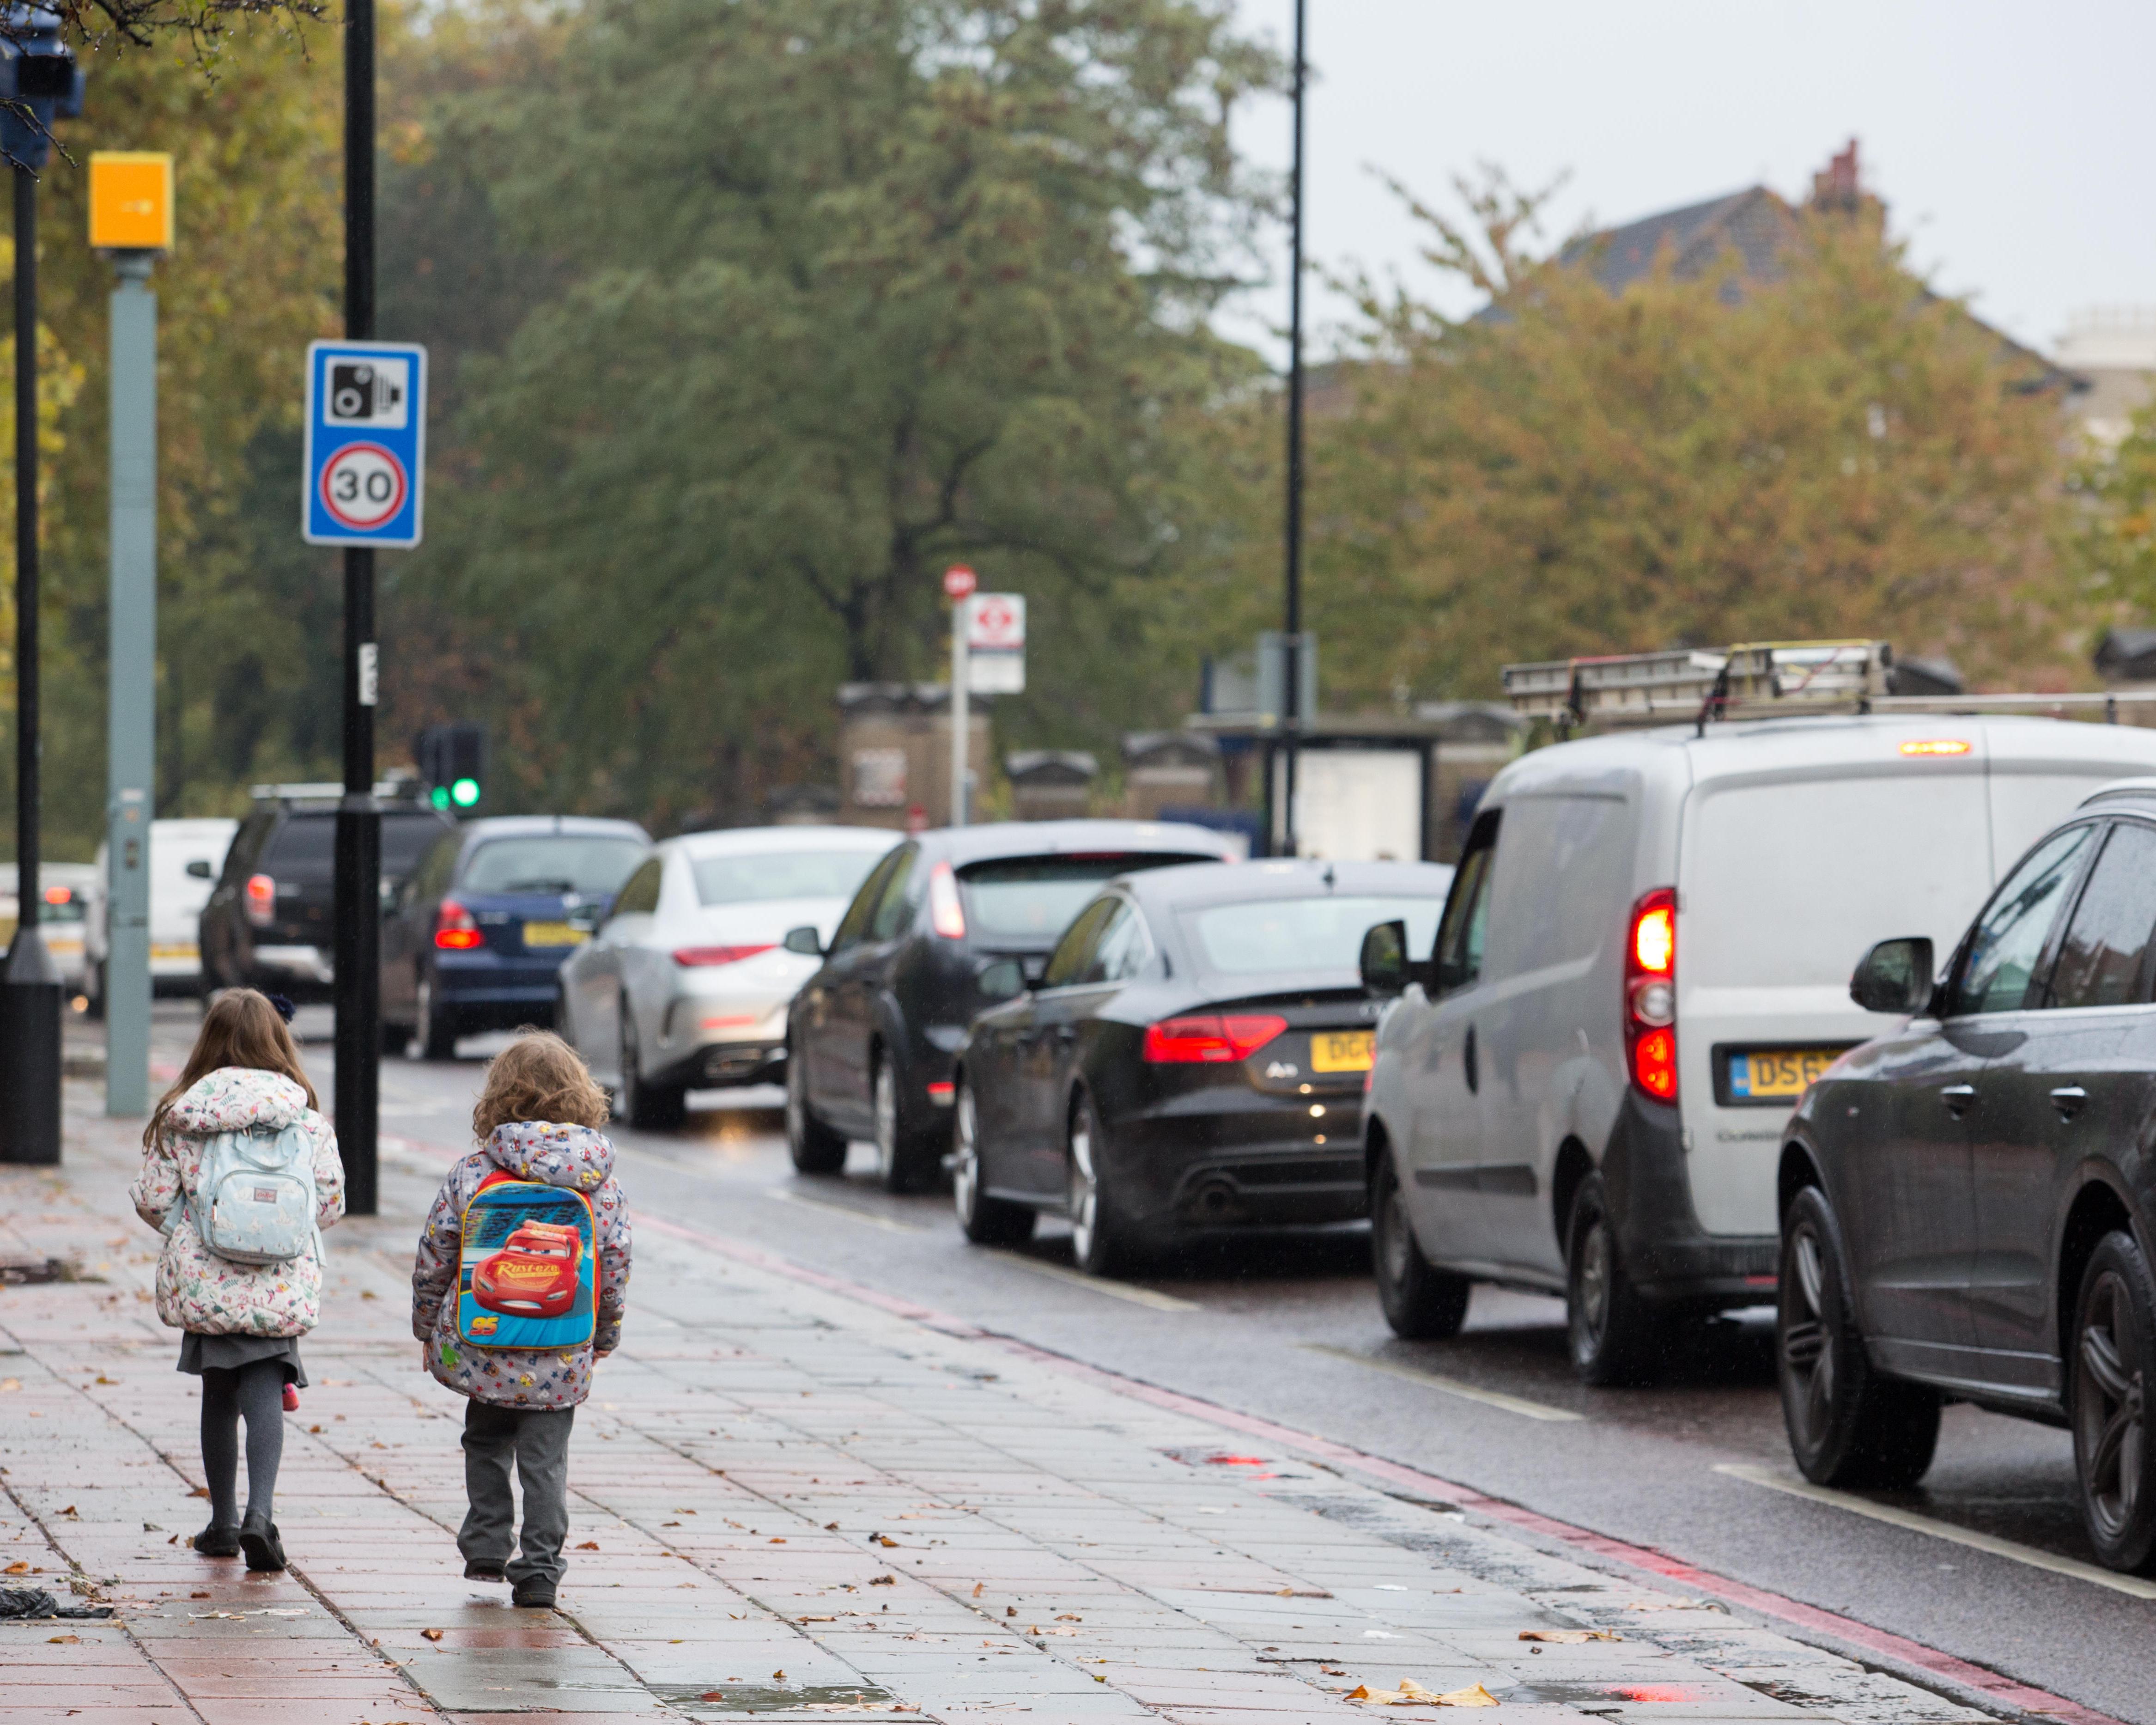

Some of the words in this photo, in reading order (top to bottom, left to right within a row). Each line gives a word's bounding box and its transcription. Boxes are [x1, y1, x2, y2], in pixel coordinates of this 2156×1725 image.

[336, 469, 391, 502] 30
[492, 1261, 561, 1279] Rust-eze
[469, 1316, 500, 1336] 95
